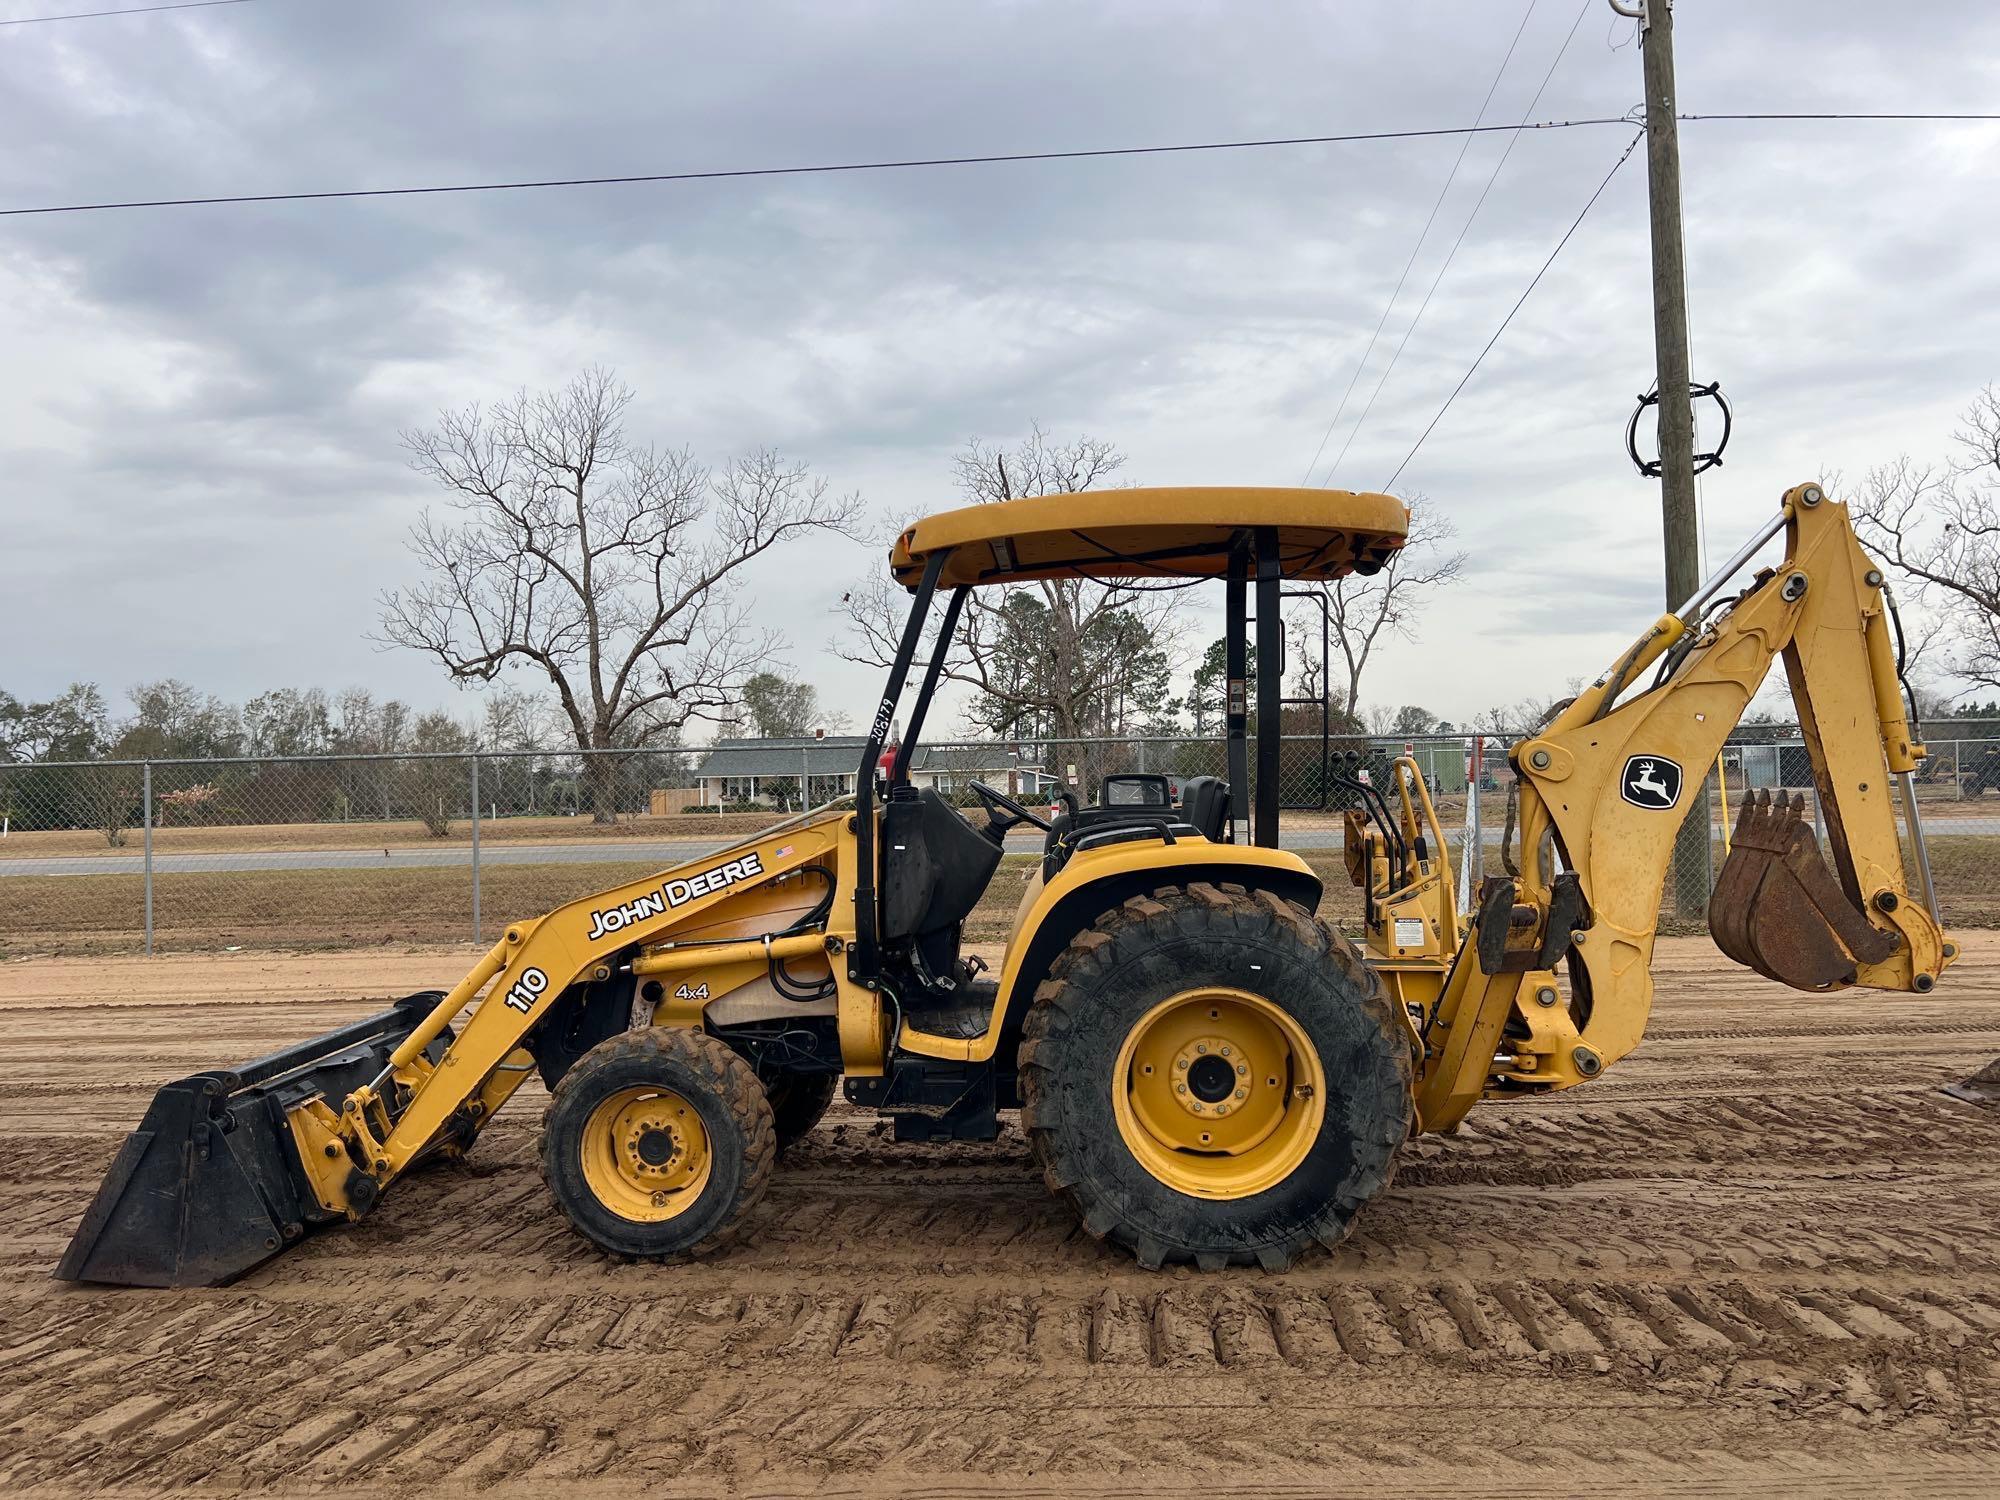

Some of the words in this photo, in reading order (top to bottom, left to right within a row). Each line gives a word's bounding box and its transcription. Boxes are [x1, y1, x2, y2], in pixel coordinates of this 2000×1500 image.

[871, 698, 894, 745] 208179
[588, 893, 665, 940] JOHN
[664, 852, 763, 908] DEERE
[505, 967, 548, 1014] 110
[675, 984, 709, 1000] 4x4
